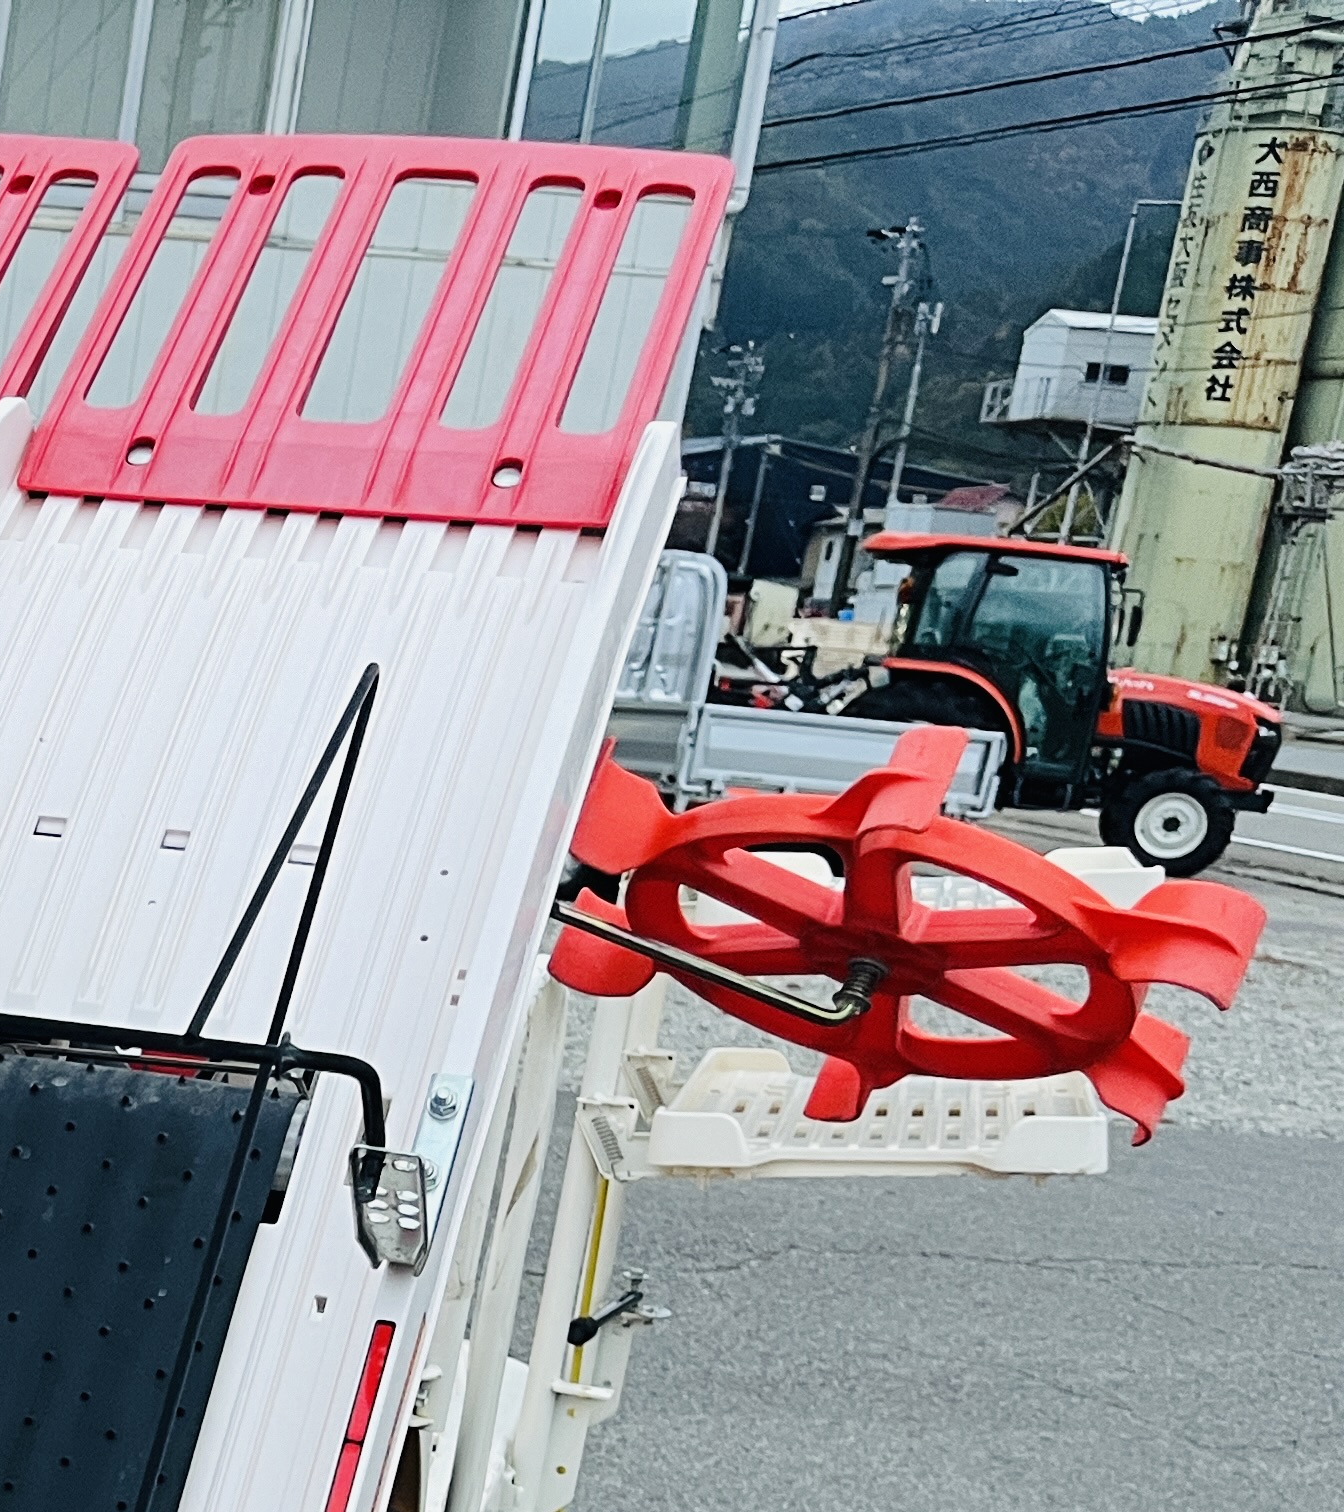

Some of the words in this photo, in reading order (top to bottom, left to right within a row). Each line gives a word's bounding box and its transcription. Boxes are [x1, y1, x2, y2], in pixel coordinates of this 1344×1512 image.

[1206, 137, 1284, 402] 大西商事株式会社
